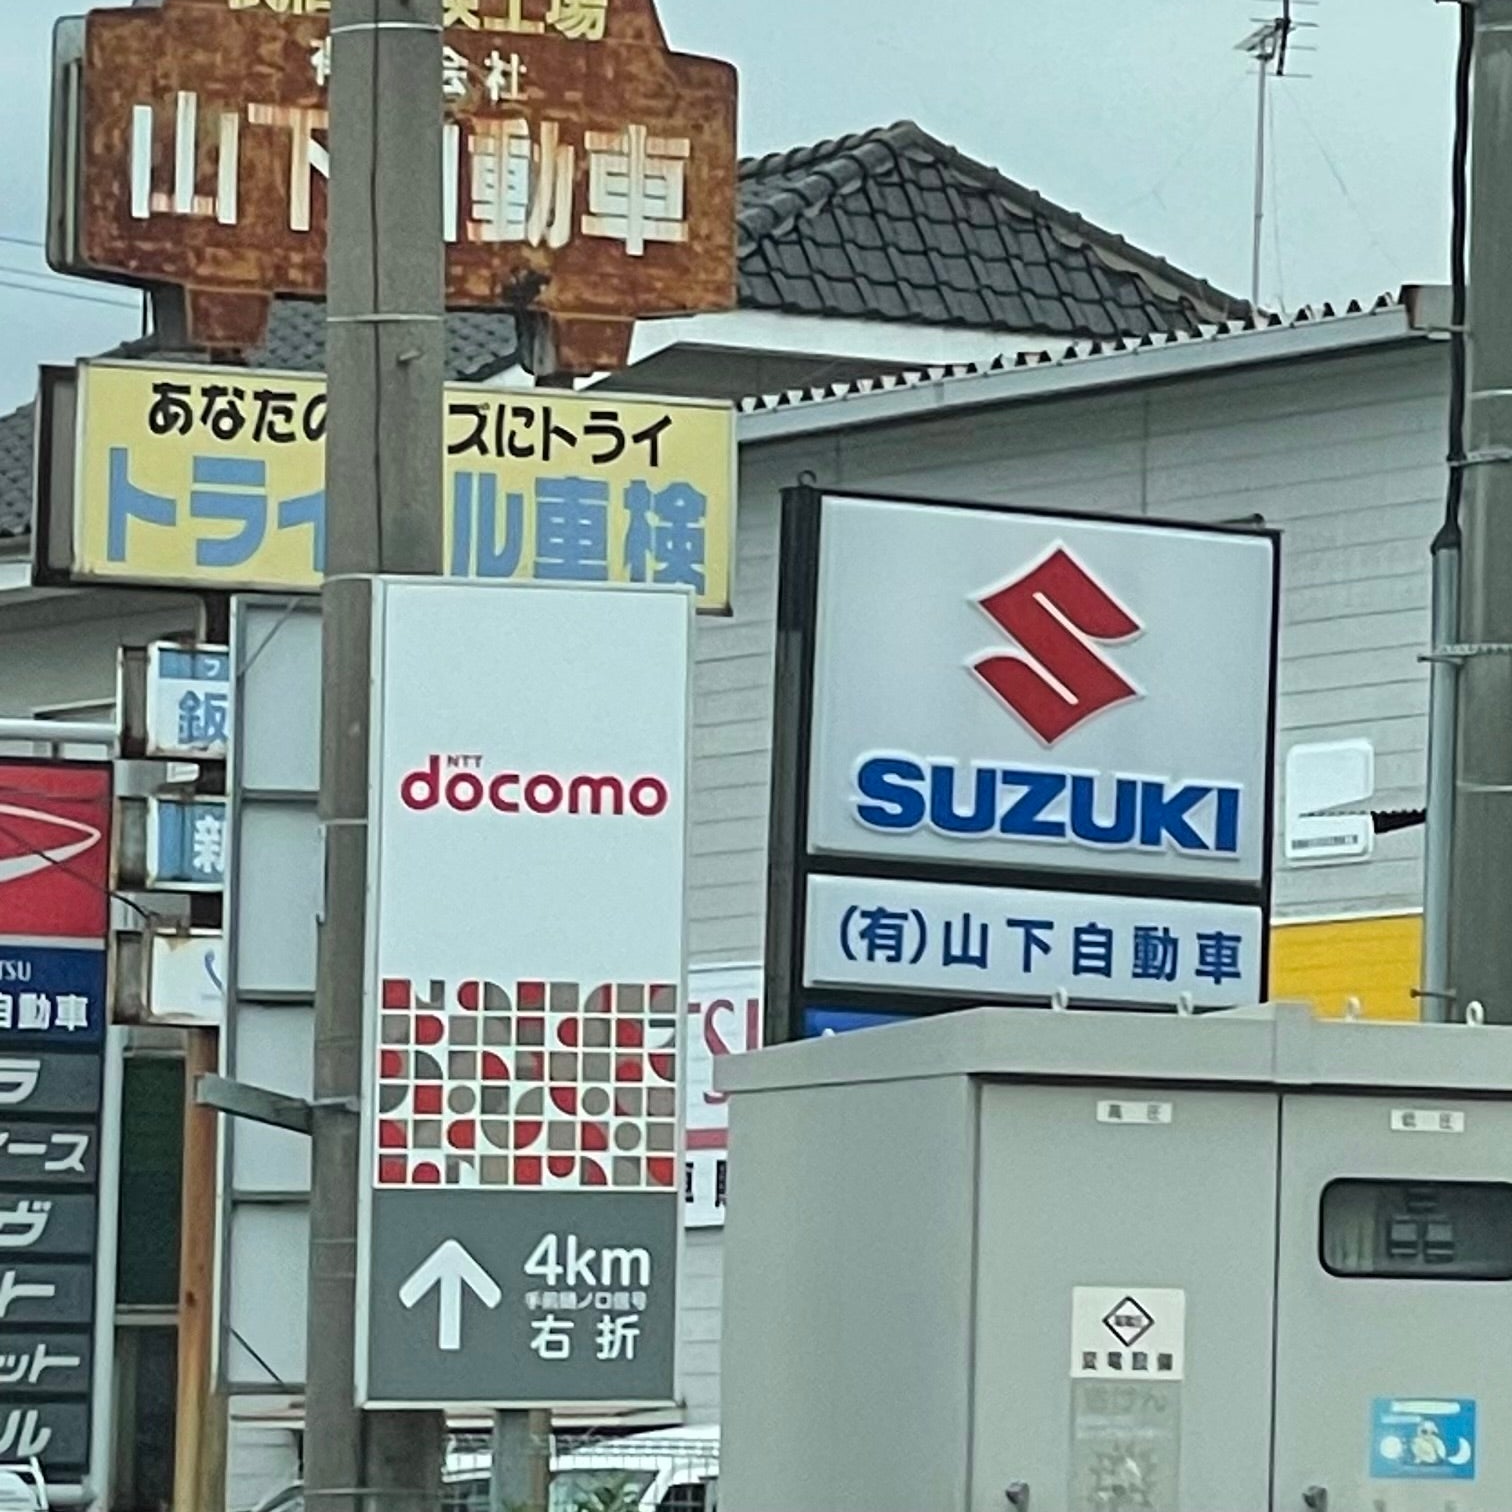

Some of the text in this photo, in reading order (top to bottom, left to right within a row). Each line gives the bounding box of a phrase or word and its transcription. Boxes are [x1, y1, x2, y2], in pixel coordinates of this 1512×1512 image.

[130, 90, 691, 256] 山下動車
[148, 381, 673, 468] あなたのズにトライ
[107, 446, 708, 596] トライル車検
[400, 754, 669, 817] docomo
[446, 754, 484, 769] NTT
[854, 756, 1243, 854] SUZUKI
[523, 1233, 651, 1287] 4km
